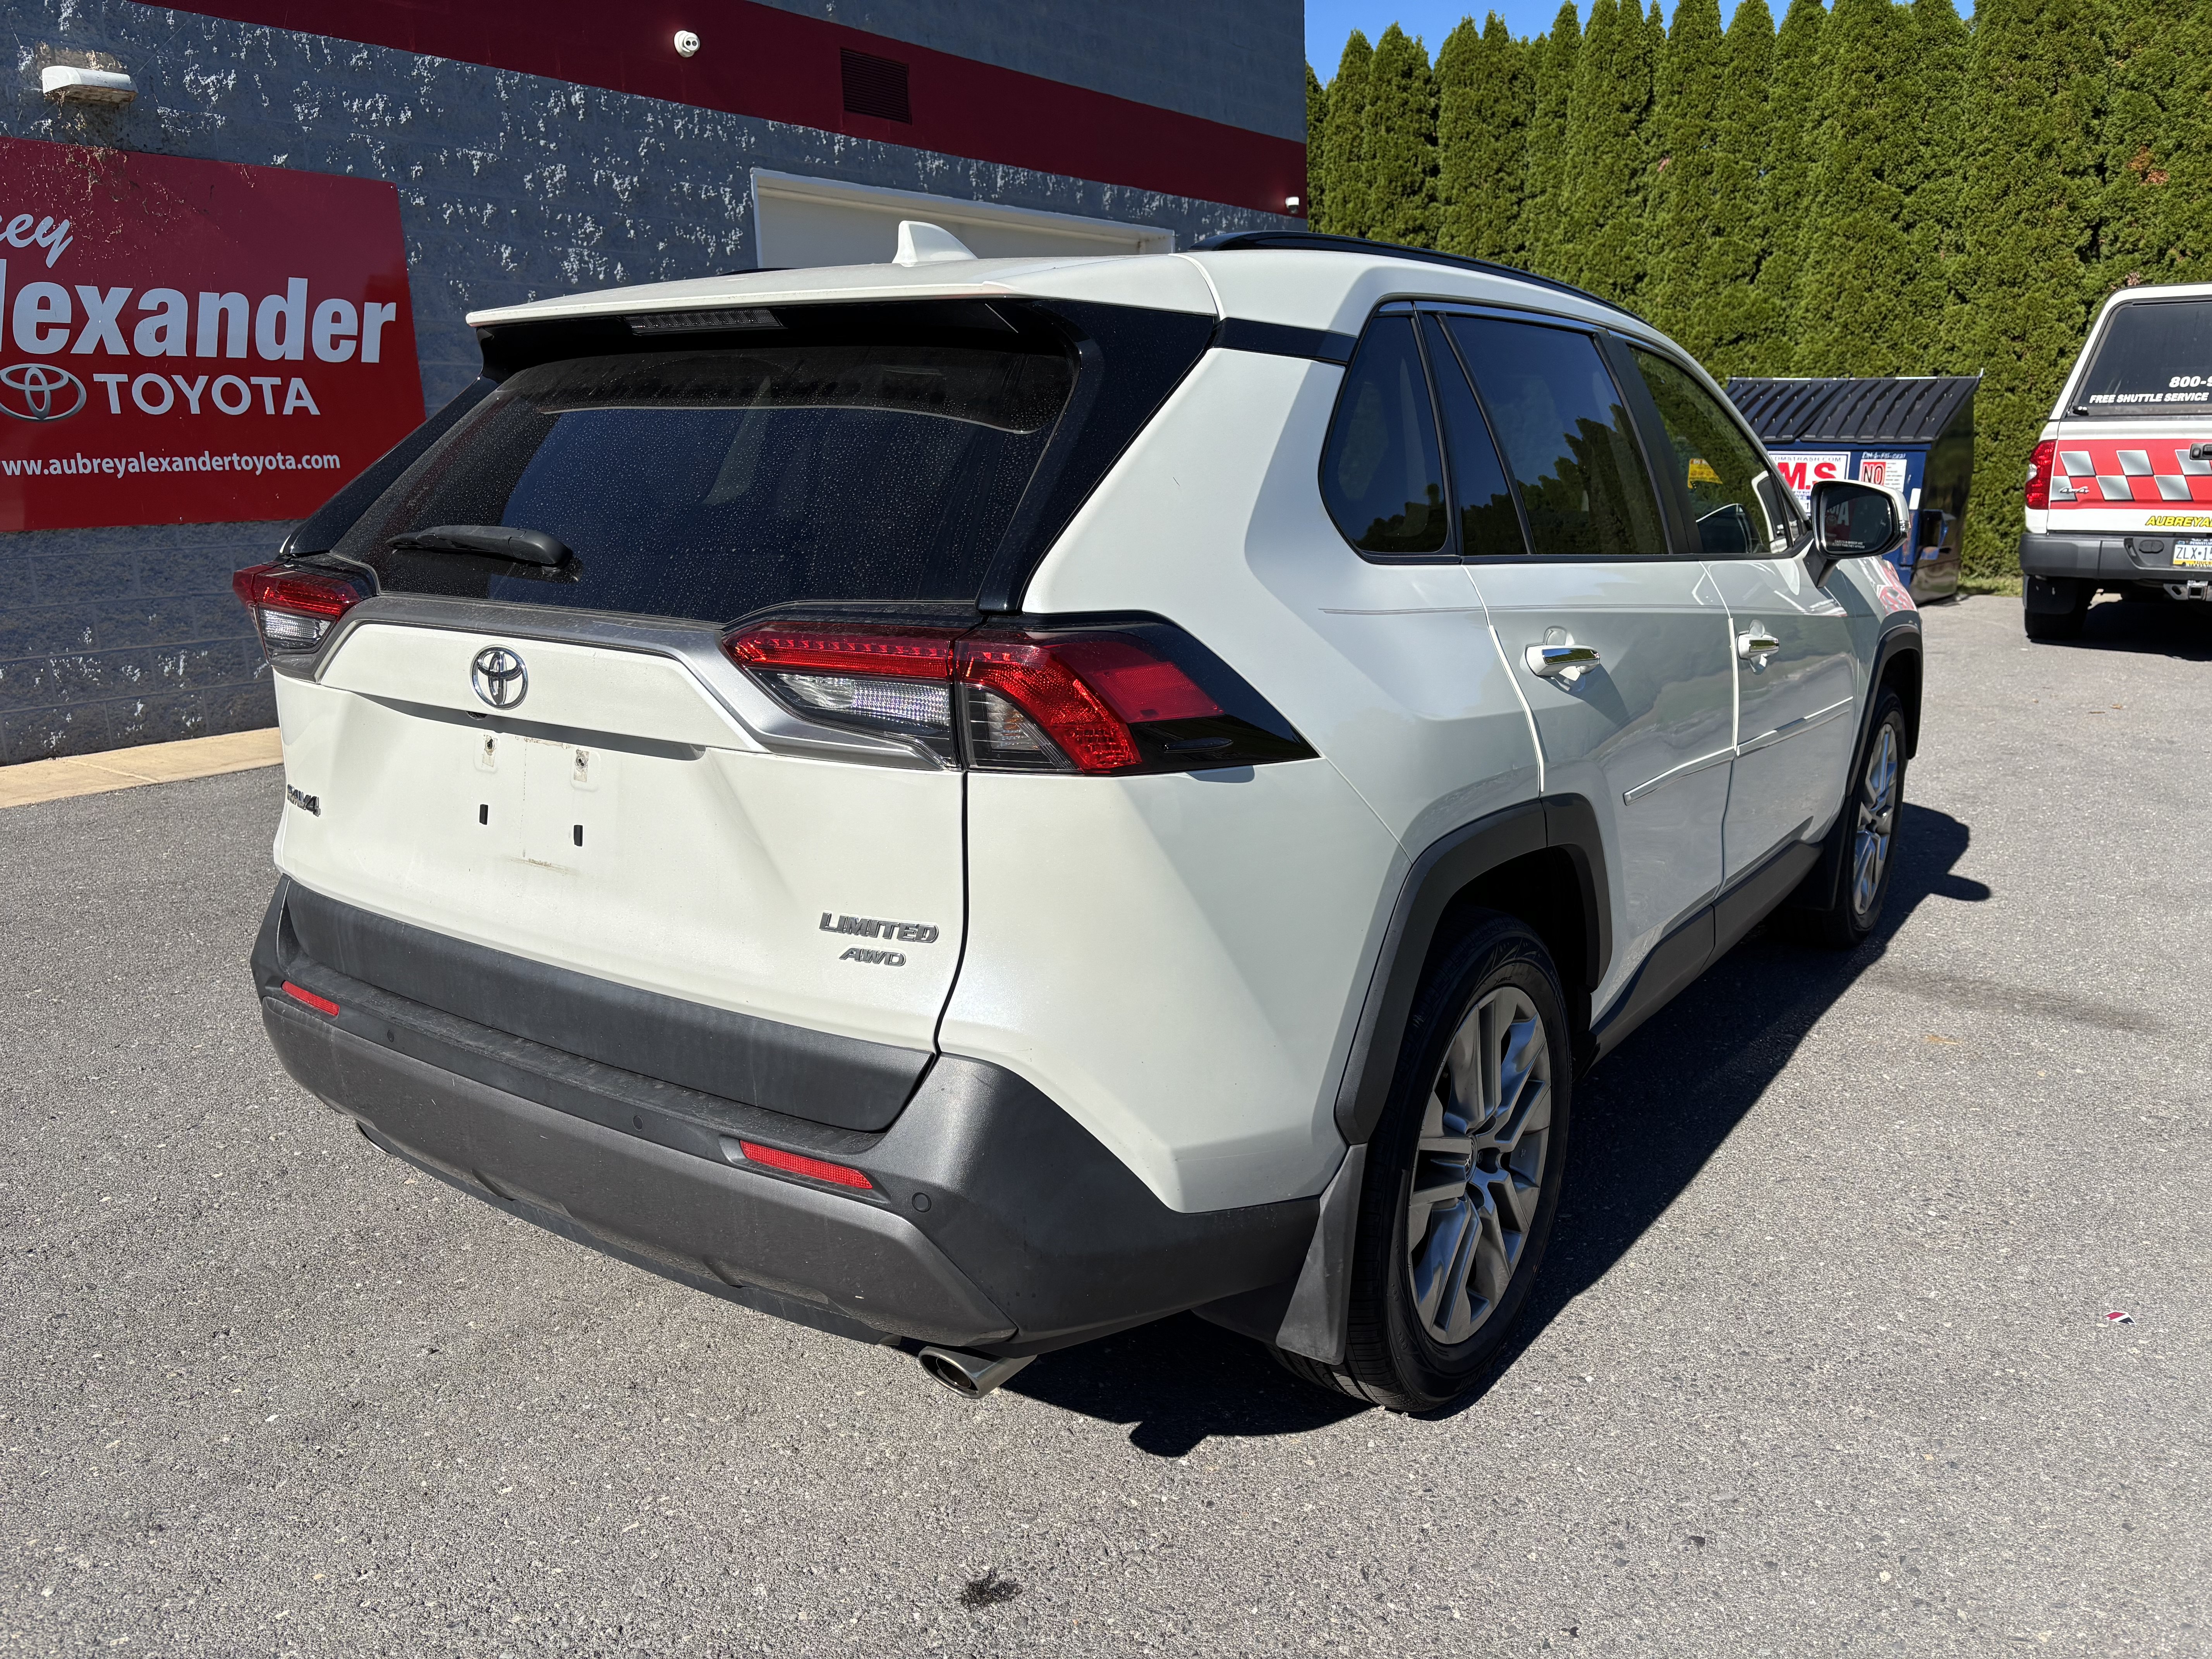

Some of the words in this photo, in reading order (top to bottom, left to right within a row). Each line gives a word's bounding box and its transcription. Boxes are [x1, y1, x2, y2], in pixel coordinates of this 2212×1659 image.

[0, 259, 396, 363] exander
[93, 373, 321, 416] TOYOTA
[2089, 394, 2116, 403] FREE
[2116, 393, 2163, 403] SHUTTLE
[2164, 392, 2209, 402] SERVICE
[0, 451, 340, 478] ww.aubreyalexandertoyota.com
[1863, 465, 1883, 484] NO
[2145, 515, 2212, 527] AUBREYA
[819, 912, 939, 943] LIMITED
[839, 948, 906, 967] AWD
